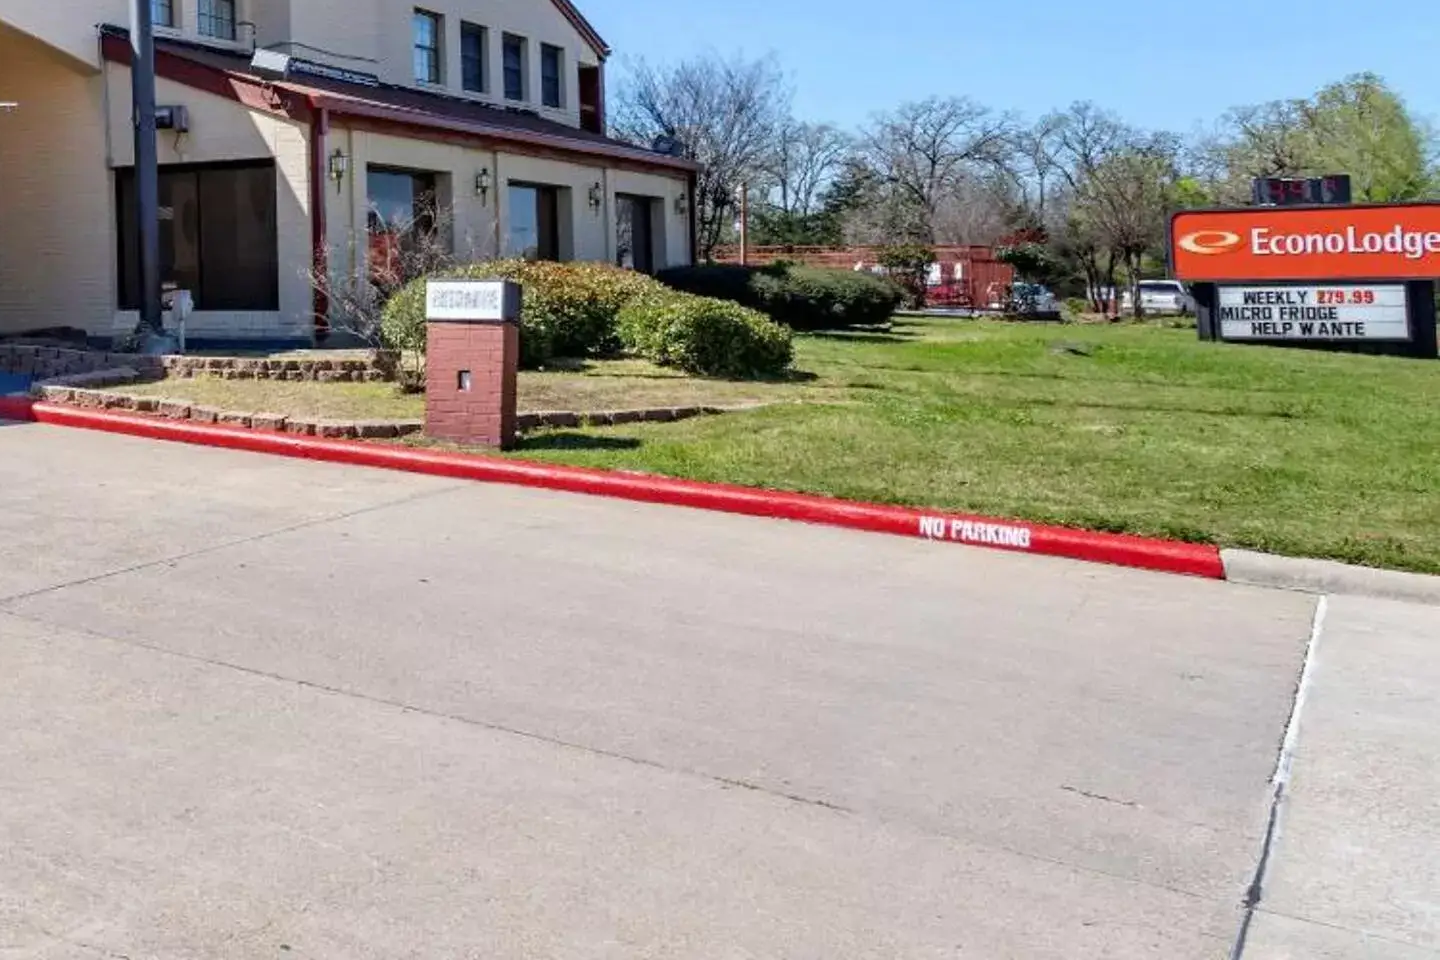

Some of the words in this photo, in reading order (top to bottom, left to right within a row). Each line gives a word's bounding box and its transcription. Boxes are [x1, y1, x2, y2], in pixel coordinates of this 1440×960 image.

[1250, 224, 1440, 259] EconoLodge
[1243, 290, 1308, 305] WEEKLY
[1220, 306, 1273, 321] MICRO
[1279, 306, 1338, 321] FRIDGE
[1251, 322, 1293, 336] HELP
[1299, 321, 1366, 337] WANTE
[919, 515, 946, 538] NO
[951, 519, 1031, 547] PARKING
